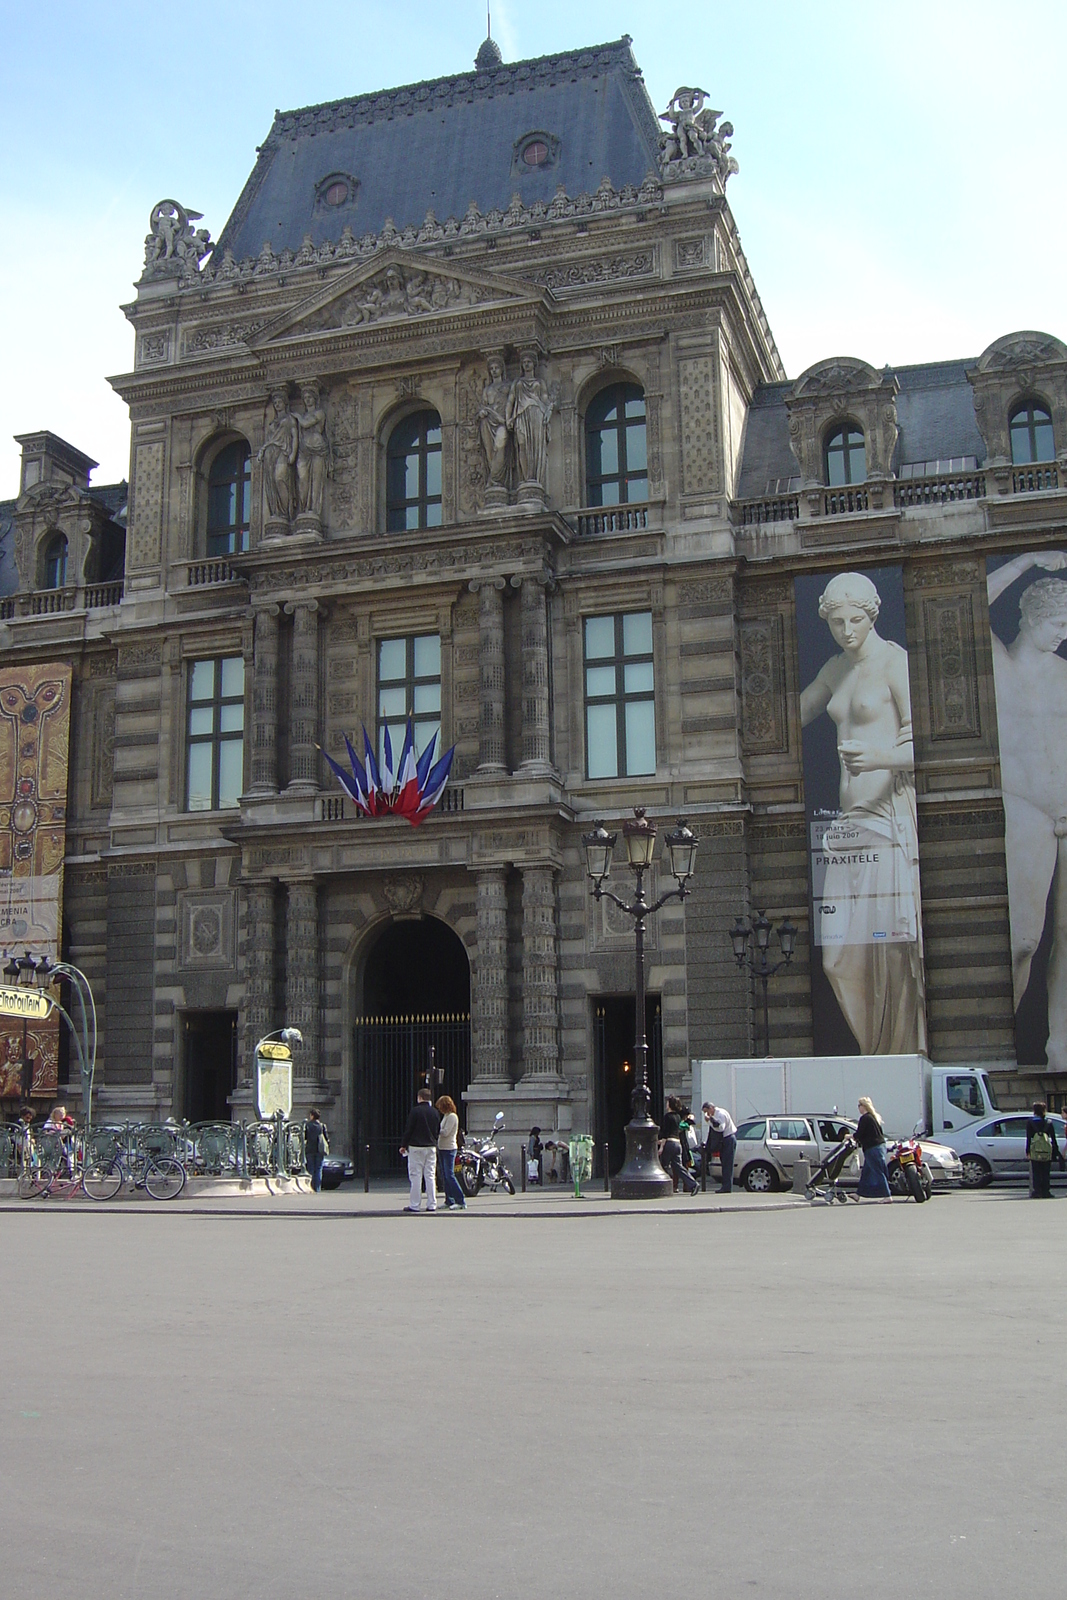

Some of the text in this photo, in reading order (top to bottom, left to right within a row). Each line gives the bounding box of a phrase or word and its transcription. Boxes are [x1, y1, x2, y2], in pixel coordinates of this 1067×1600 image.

[826, 832, 841, 841] juin
[1, 907, 28, 915] MENIA
[0, 918, 17, 926] CRA
